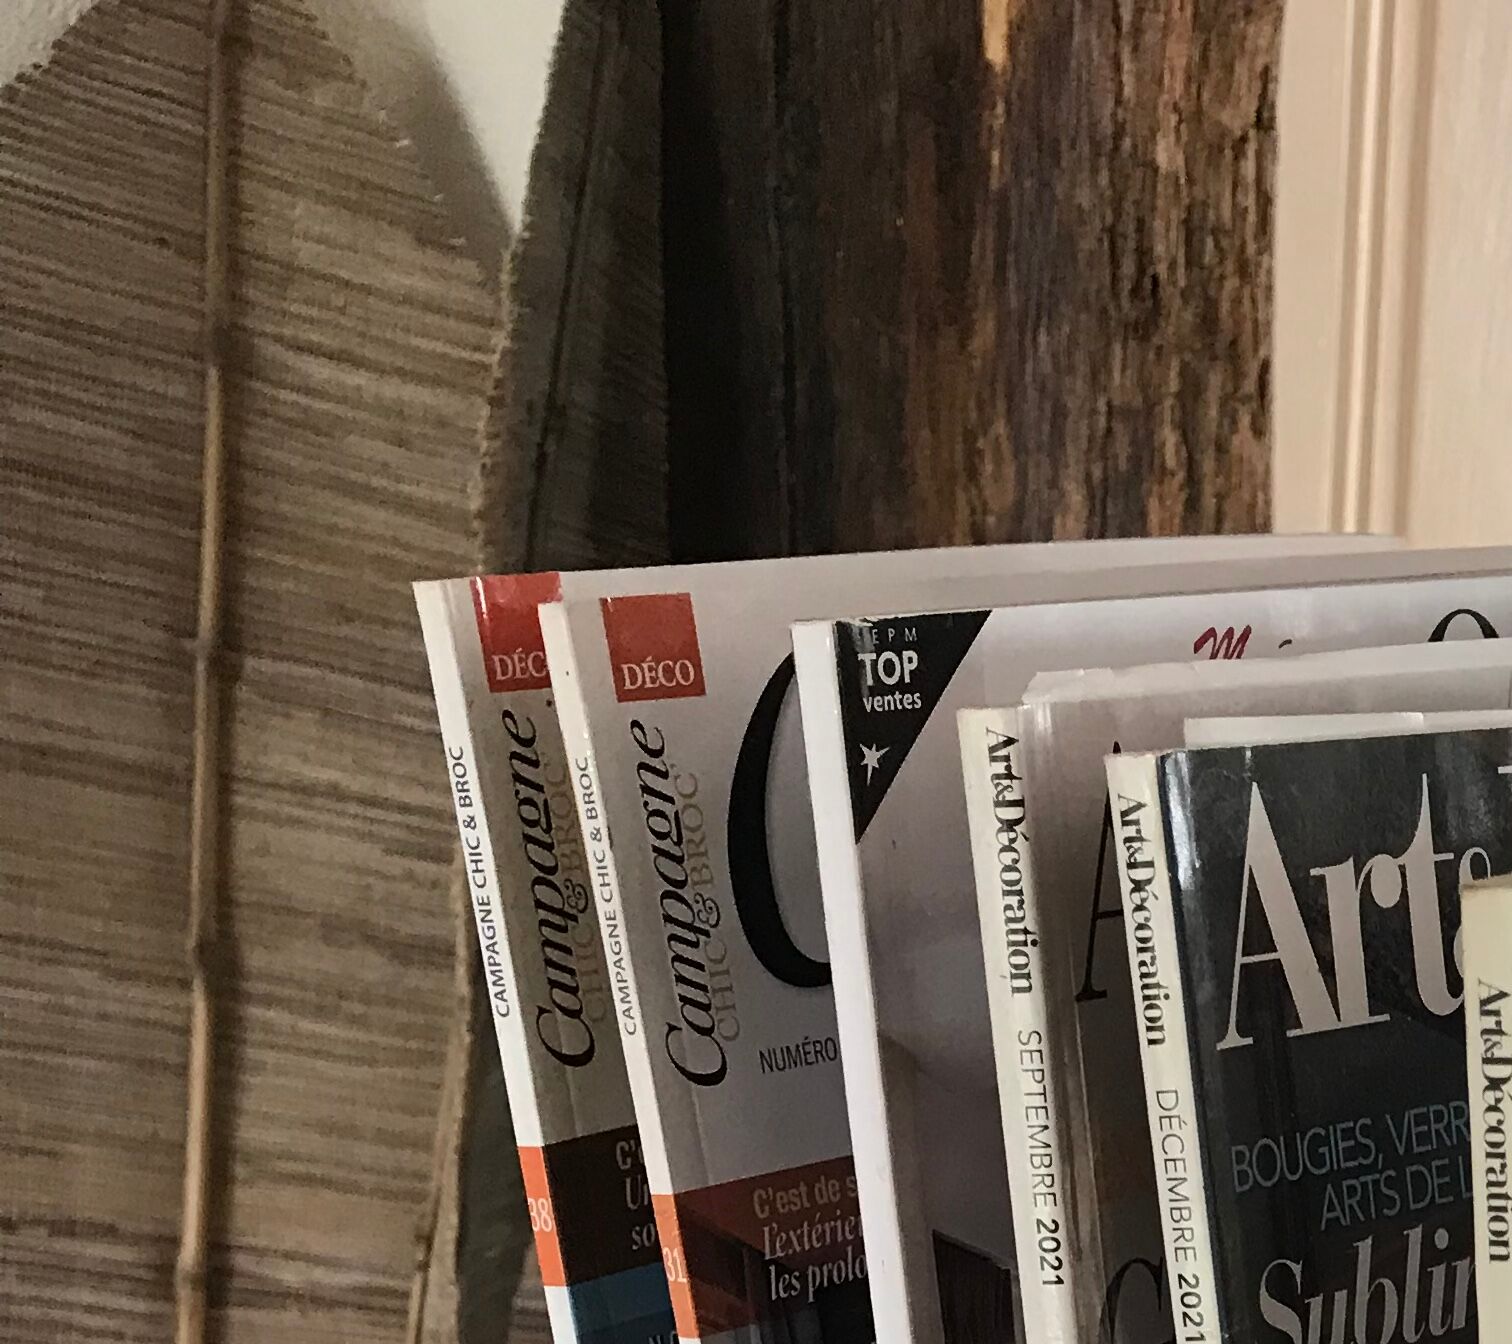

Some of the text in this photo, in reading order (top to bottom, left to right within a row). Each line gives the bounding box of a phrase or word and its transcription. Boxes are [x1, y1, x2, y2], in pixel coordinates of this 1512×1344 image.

[493, 646, 548, 682] DÉC
[623, 659, 695, 691] DÉCO
[857, 650, 919, 686] TOP
[863, 690, 922, 713] ventes
[448, 746, 511, 1018] CAMPAGNE CHIC & BROC
[502, 708, 596, 1068] Campagne
[575, 756, 637, 1036] CAMPAGNE CHIC & BROC
[630, 719, 728, 1086] Campagne
[674, 770, 740, 1042] CHIC & BROC
[986, 726, 1066, 1288] Art&Décoration SEPTEMBRE 2021
[759, 1034, 839, 1075] NUMÉRO
[1118, 792, 1207, 1343] Art&Décoration DÉCEMBRE 2021
[1232, 1117, 1384, 1194] BOUGIES,
[1386, 1100, 1471, 1157] VERR
[753, 1182, 812, 1219] C'est
[814, 1174, 842, 1205] de
[1321, 1167, 1400, 1232] ARTS
[1406, 1161, 1452, 1212] DE
[662, 1247, 688, 1284] 31
[769, 1245, 869, 1304] les prolo
